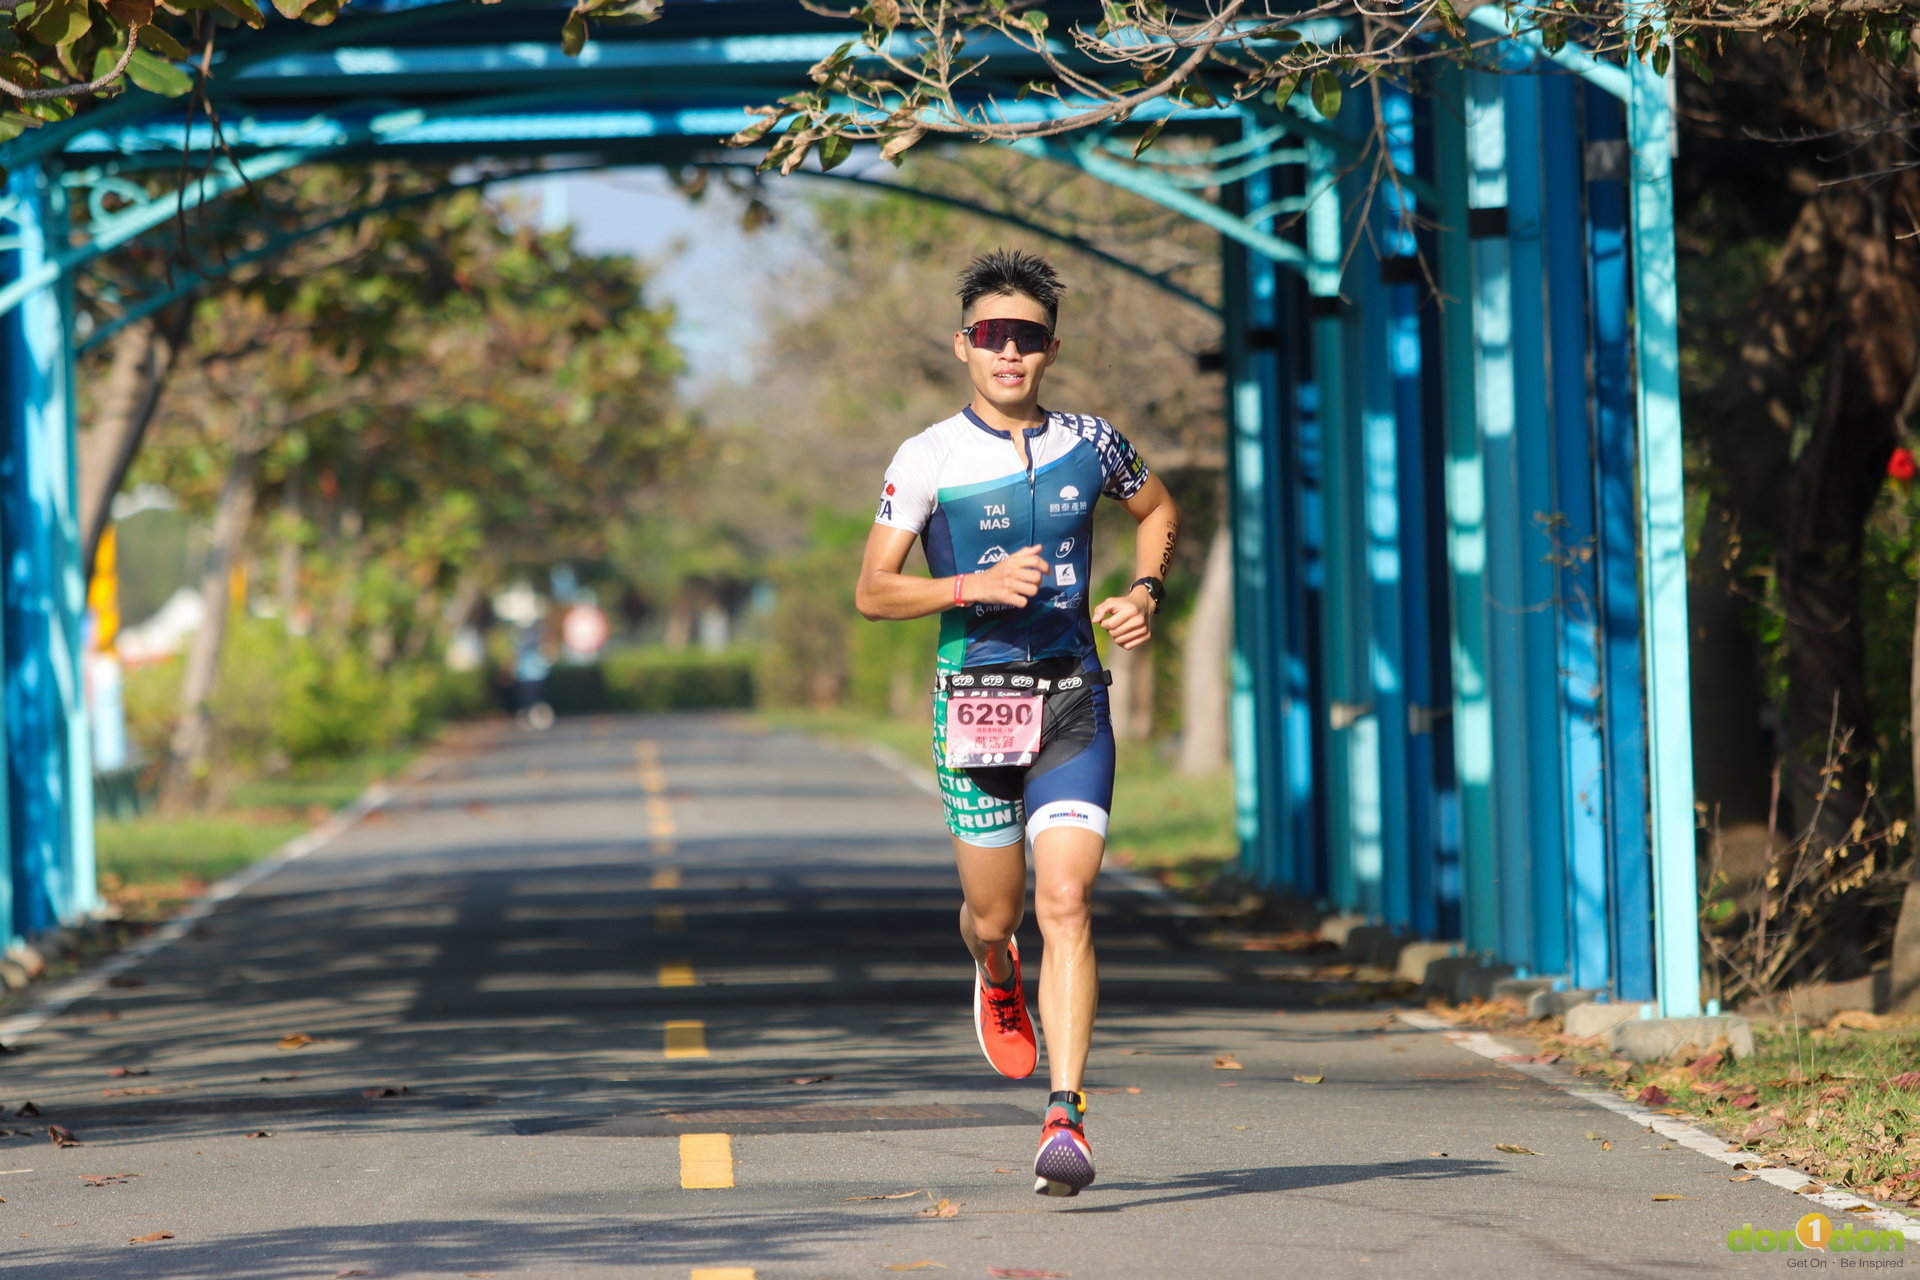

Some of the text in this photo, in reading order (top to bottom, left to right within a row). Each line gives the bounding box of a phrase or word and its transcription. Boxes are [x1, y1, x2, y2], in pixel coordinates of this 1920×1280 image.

[984, 504, 1006, 517] TAI
[979, 518, 1011, 531] MAS
[1160, 531, 1175, 577] 6290
[957, 703, 1033, 726] 6290
[957, 808, 1012, 829] RUN
